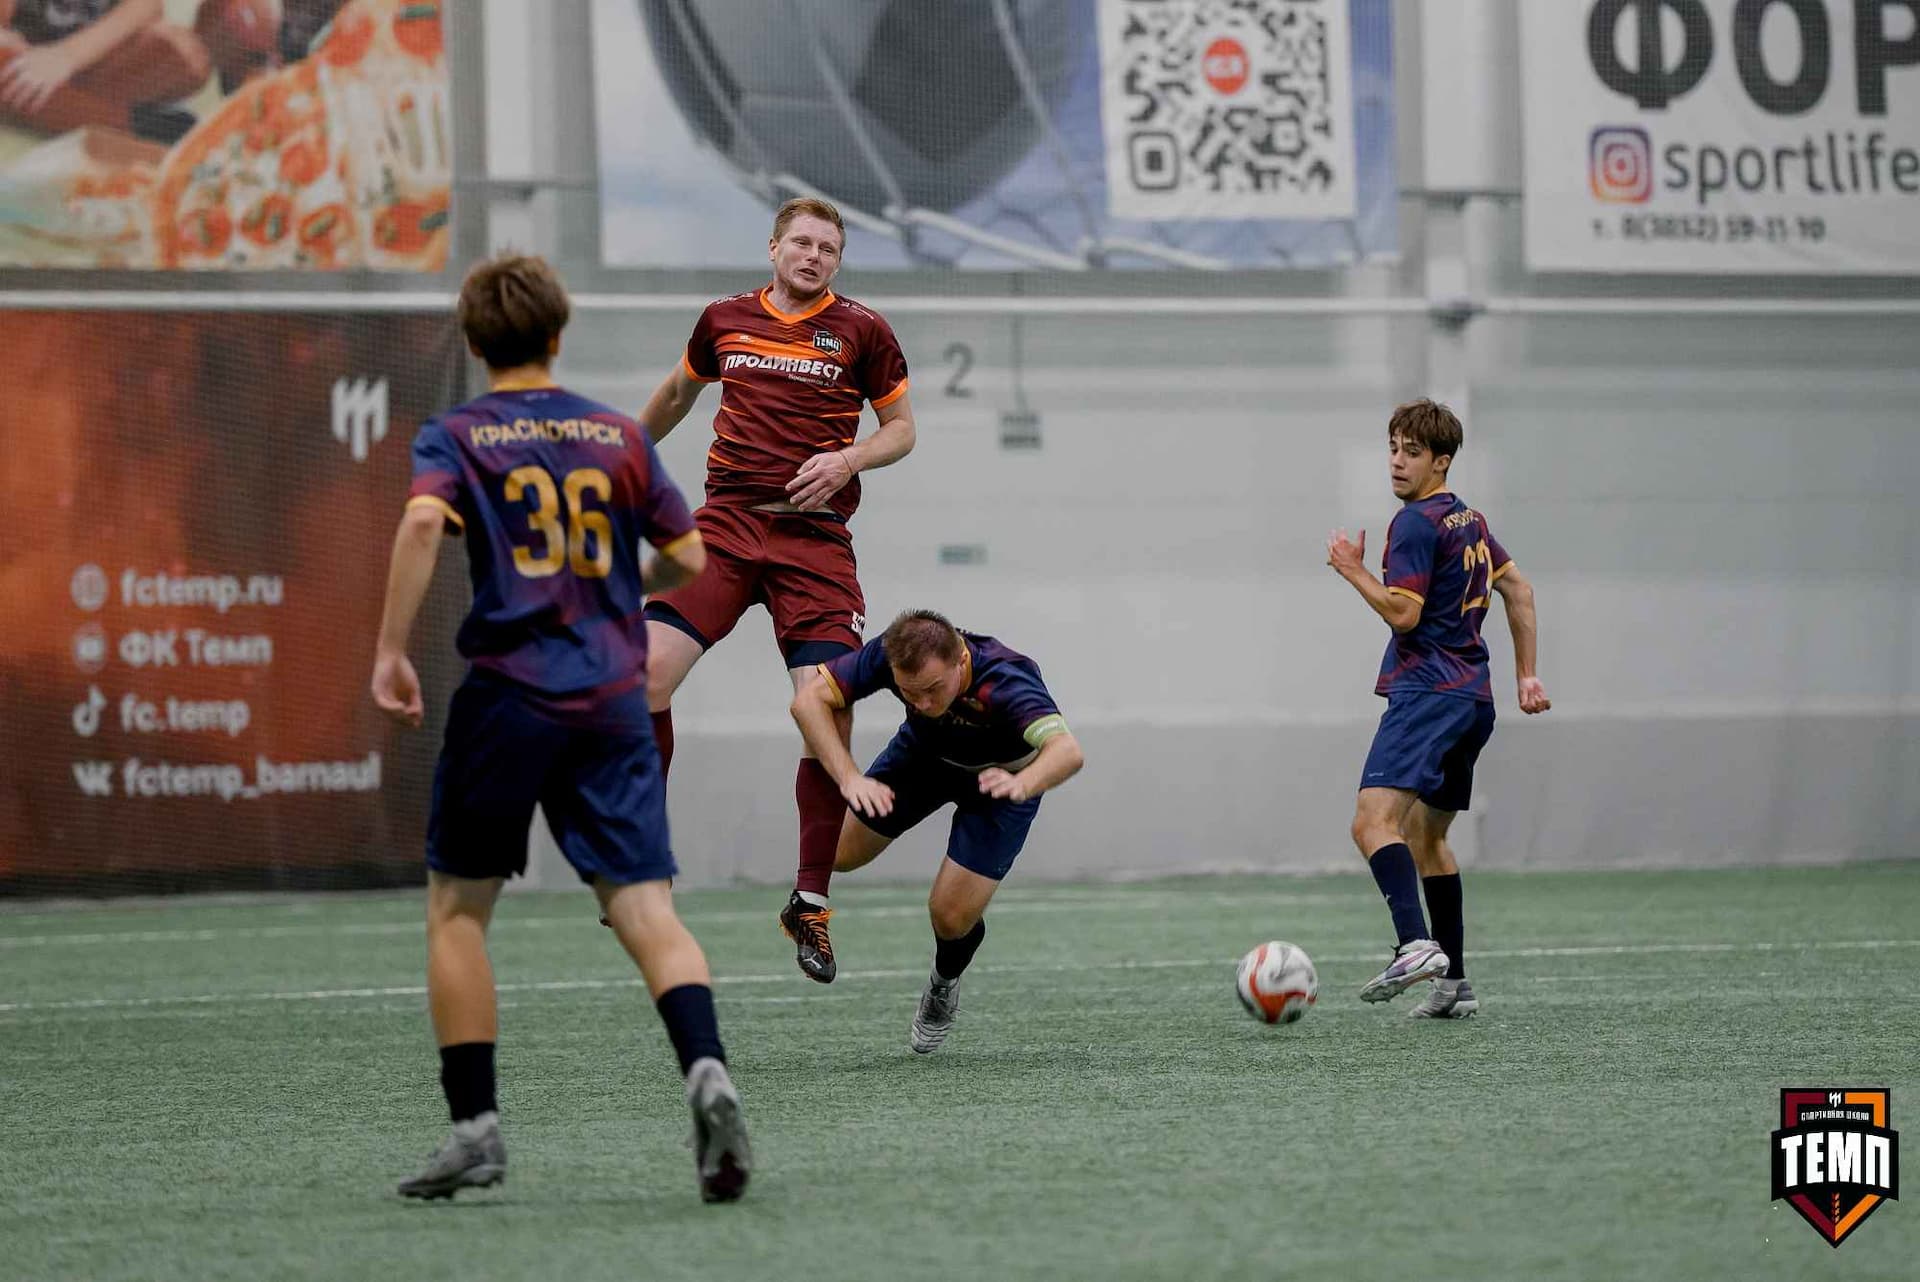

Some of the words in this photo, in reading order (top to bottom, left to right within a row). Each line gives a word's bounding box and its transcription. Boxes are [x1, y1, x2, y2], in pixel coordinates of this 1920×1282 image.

[1663, 132, 1920, 206] sportlife
[723, 354, 844, 380] ПРОДИНВЕСТ
[942, 342, 976, 399] 2
[469, 417, 625, 448] КРАСНОЯРСК
[503, 465, 613, 579] 36
[120, 570, 284, 613] fctemp.ru
[118, 630, 178, 667] ФК
[184, 629, 274, 665] Темп
[119, 692, 251, 737] fc.temp
[123, 751, 382, 802] fctemp_barnaul
